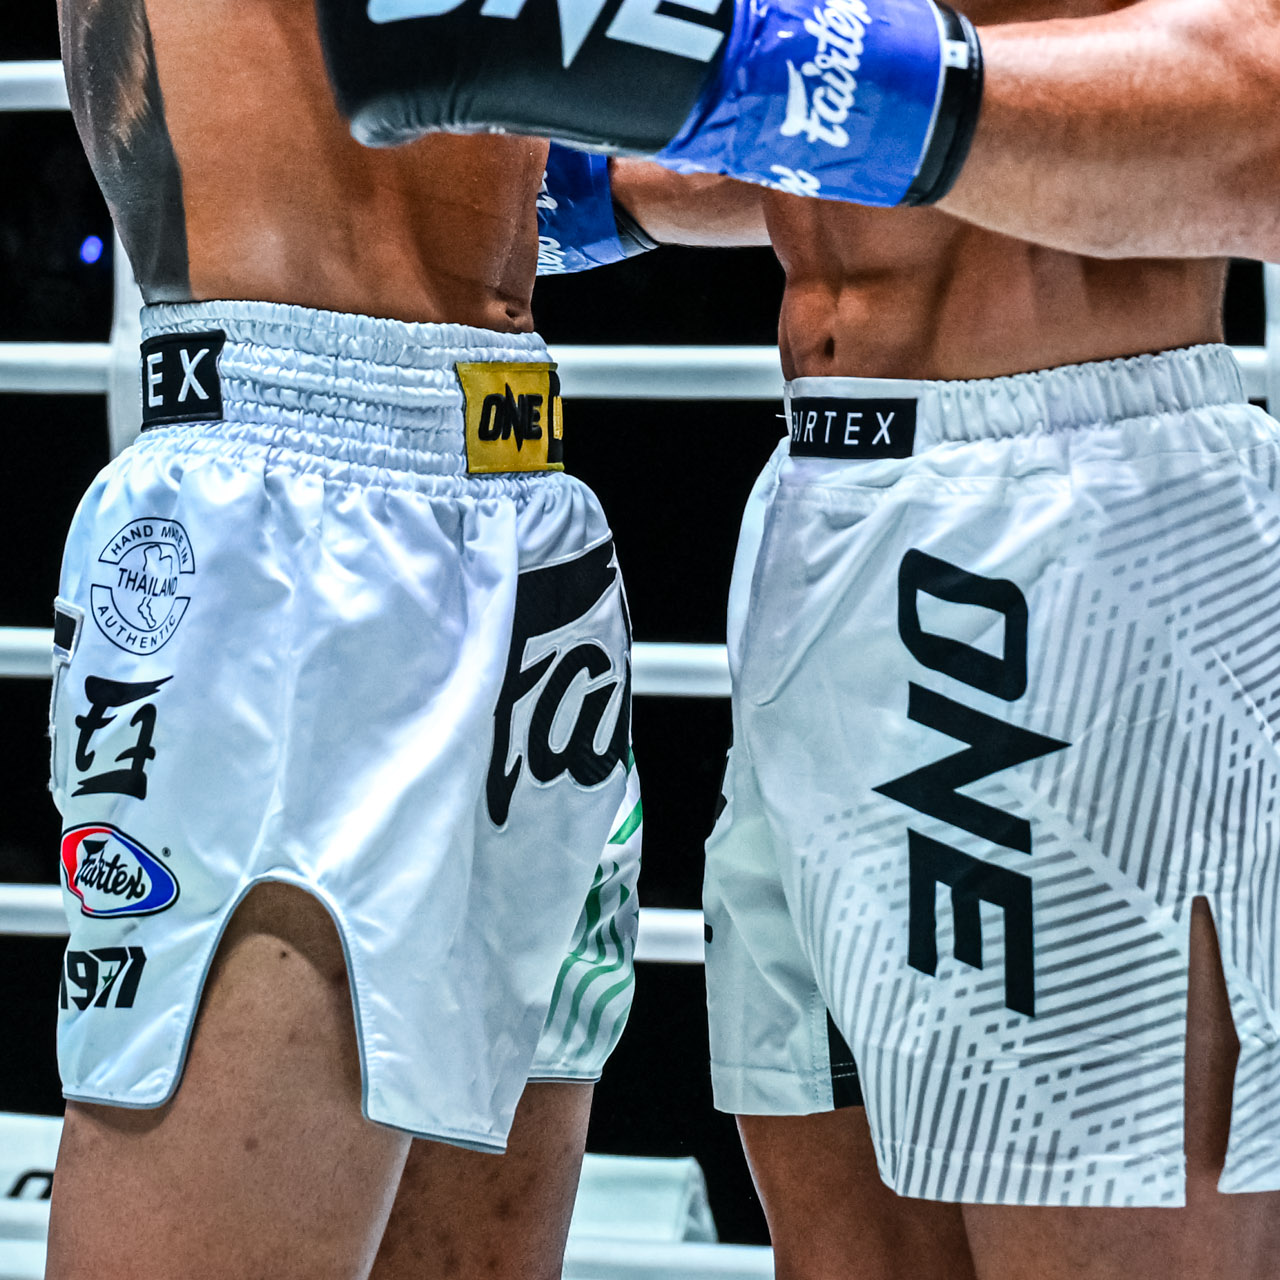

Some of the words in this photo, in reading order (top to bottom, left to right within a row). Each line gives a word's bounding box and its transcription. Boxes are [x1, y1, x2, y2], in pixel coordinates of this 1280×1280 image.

[478, 382, 543, 452] ONE
[111, 525, 153, 555] HAND
[161, 526, 184, 548] MADE
[180, 546, 189, 565] IN
[118, 568, 178, 596] THAILAND
[97, 606, 176, 649] AUTHENTIC
[871, 548, 1071, 1019] ONE
